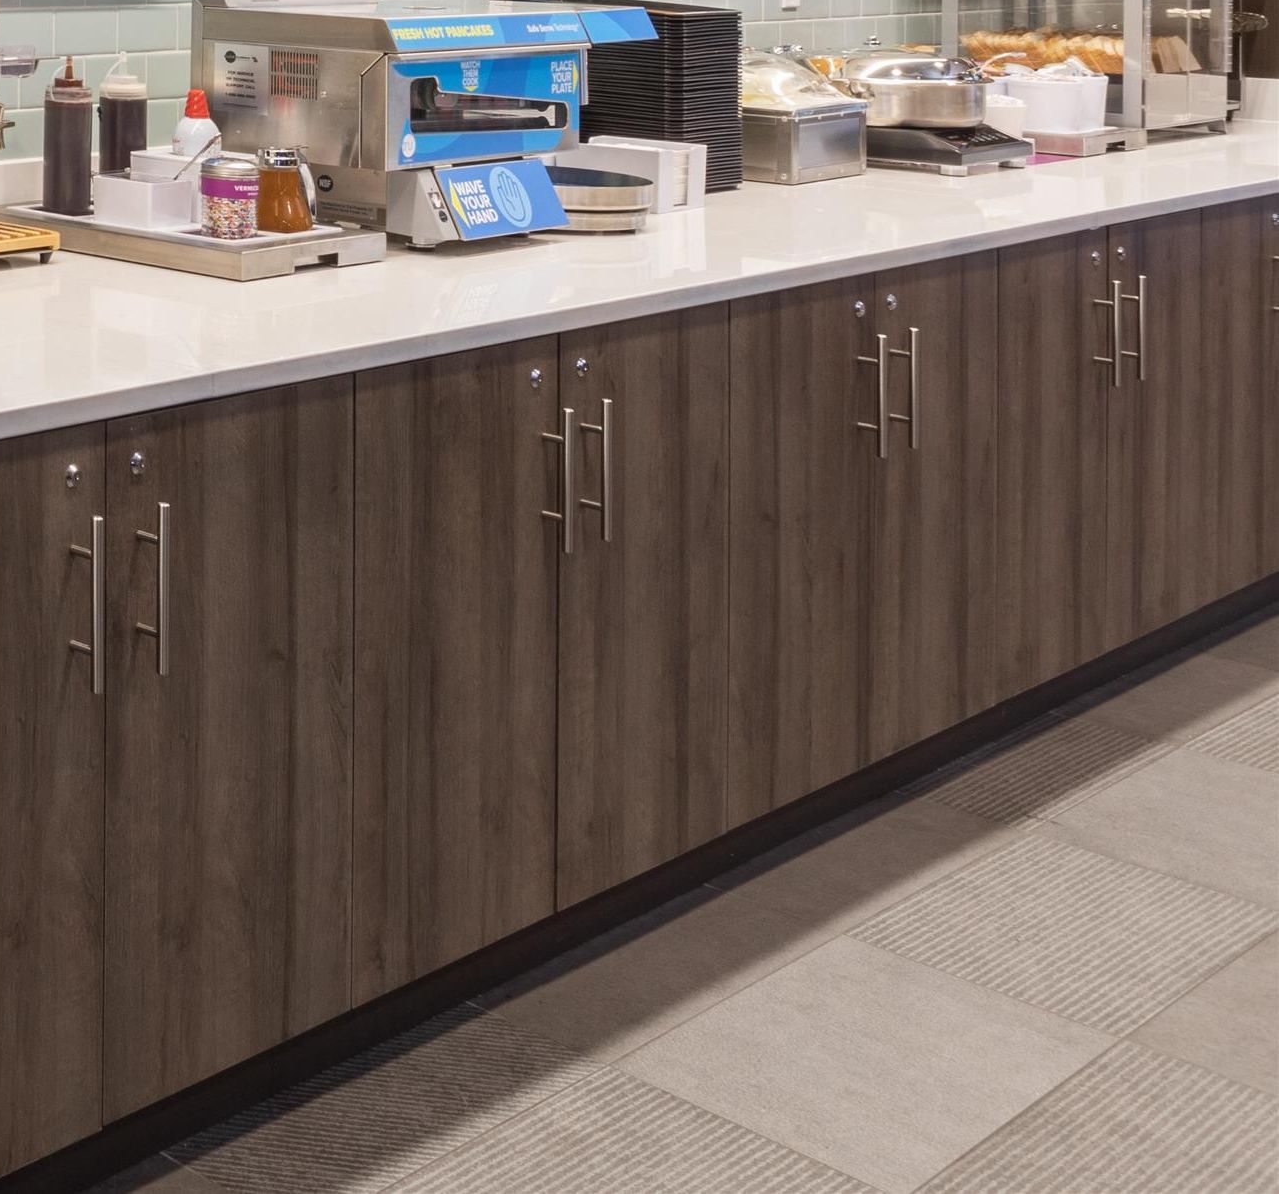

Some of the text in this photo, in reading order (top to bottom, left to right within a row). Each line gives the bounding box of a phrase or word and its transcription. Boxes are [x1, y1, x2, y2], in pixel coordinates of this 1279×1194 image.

[392, 24, 494, 41] FRESH HOT PANCAKES
[460, 61, 481, 70] WATCH
[550, 60, 573, 72] PLACE
[462, 69, 478, 78] THEM
[552, 72, 572, 83] YOUR
[462, 77, 478, 87] COOK
[551, 83, 573, 94] PLATE
[318, 178, 332, 188] NSF
[454, 179, 486, 196] WAVE
[462, 194, 492, 209] YOUR
[467, 209, 499, 225] HAND
